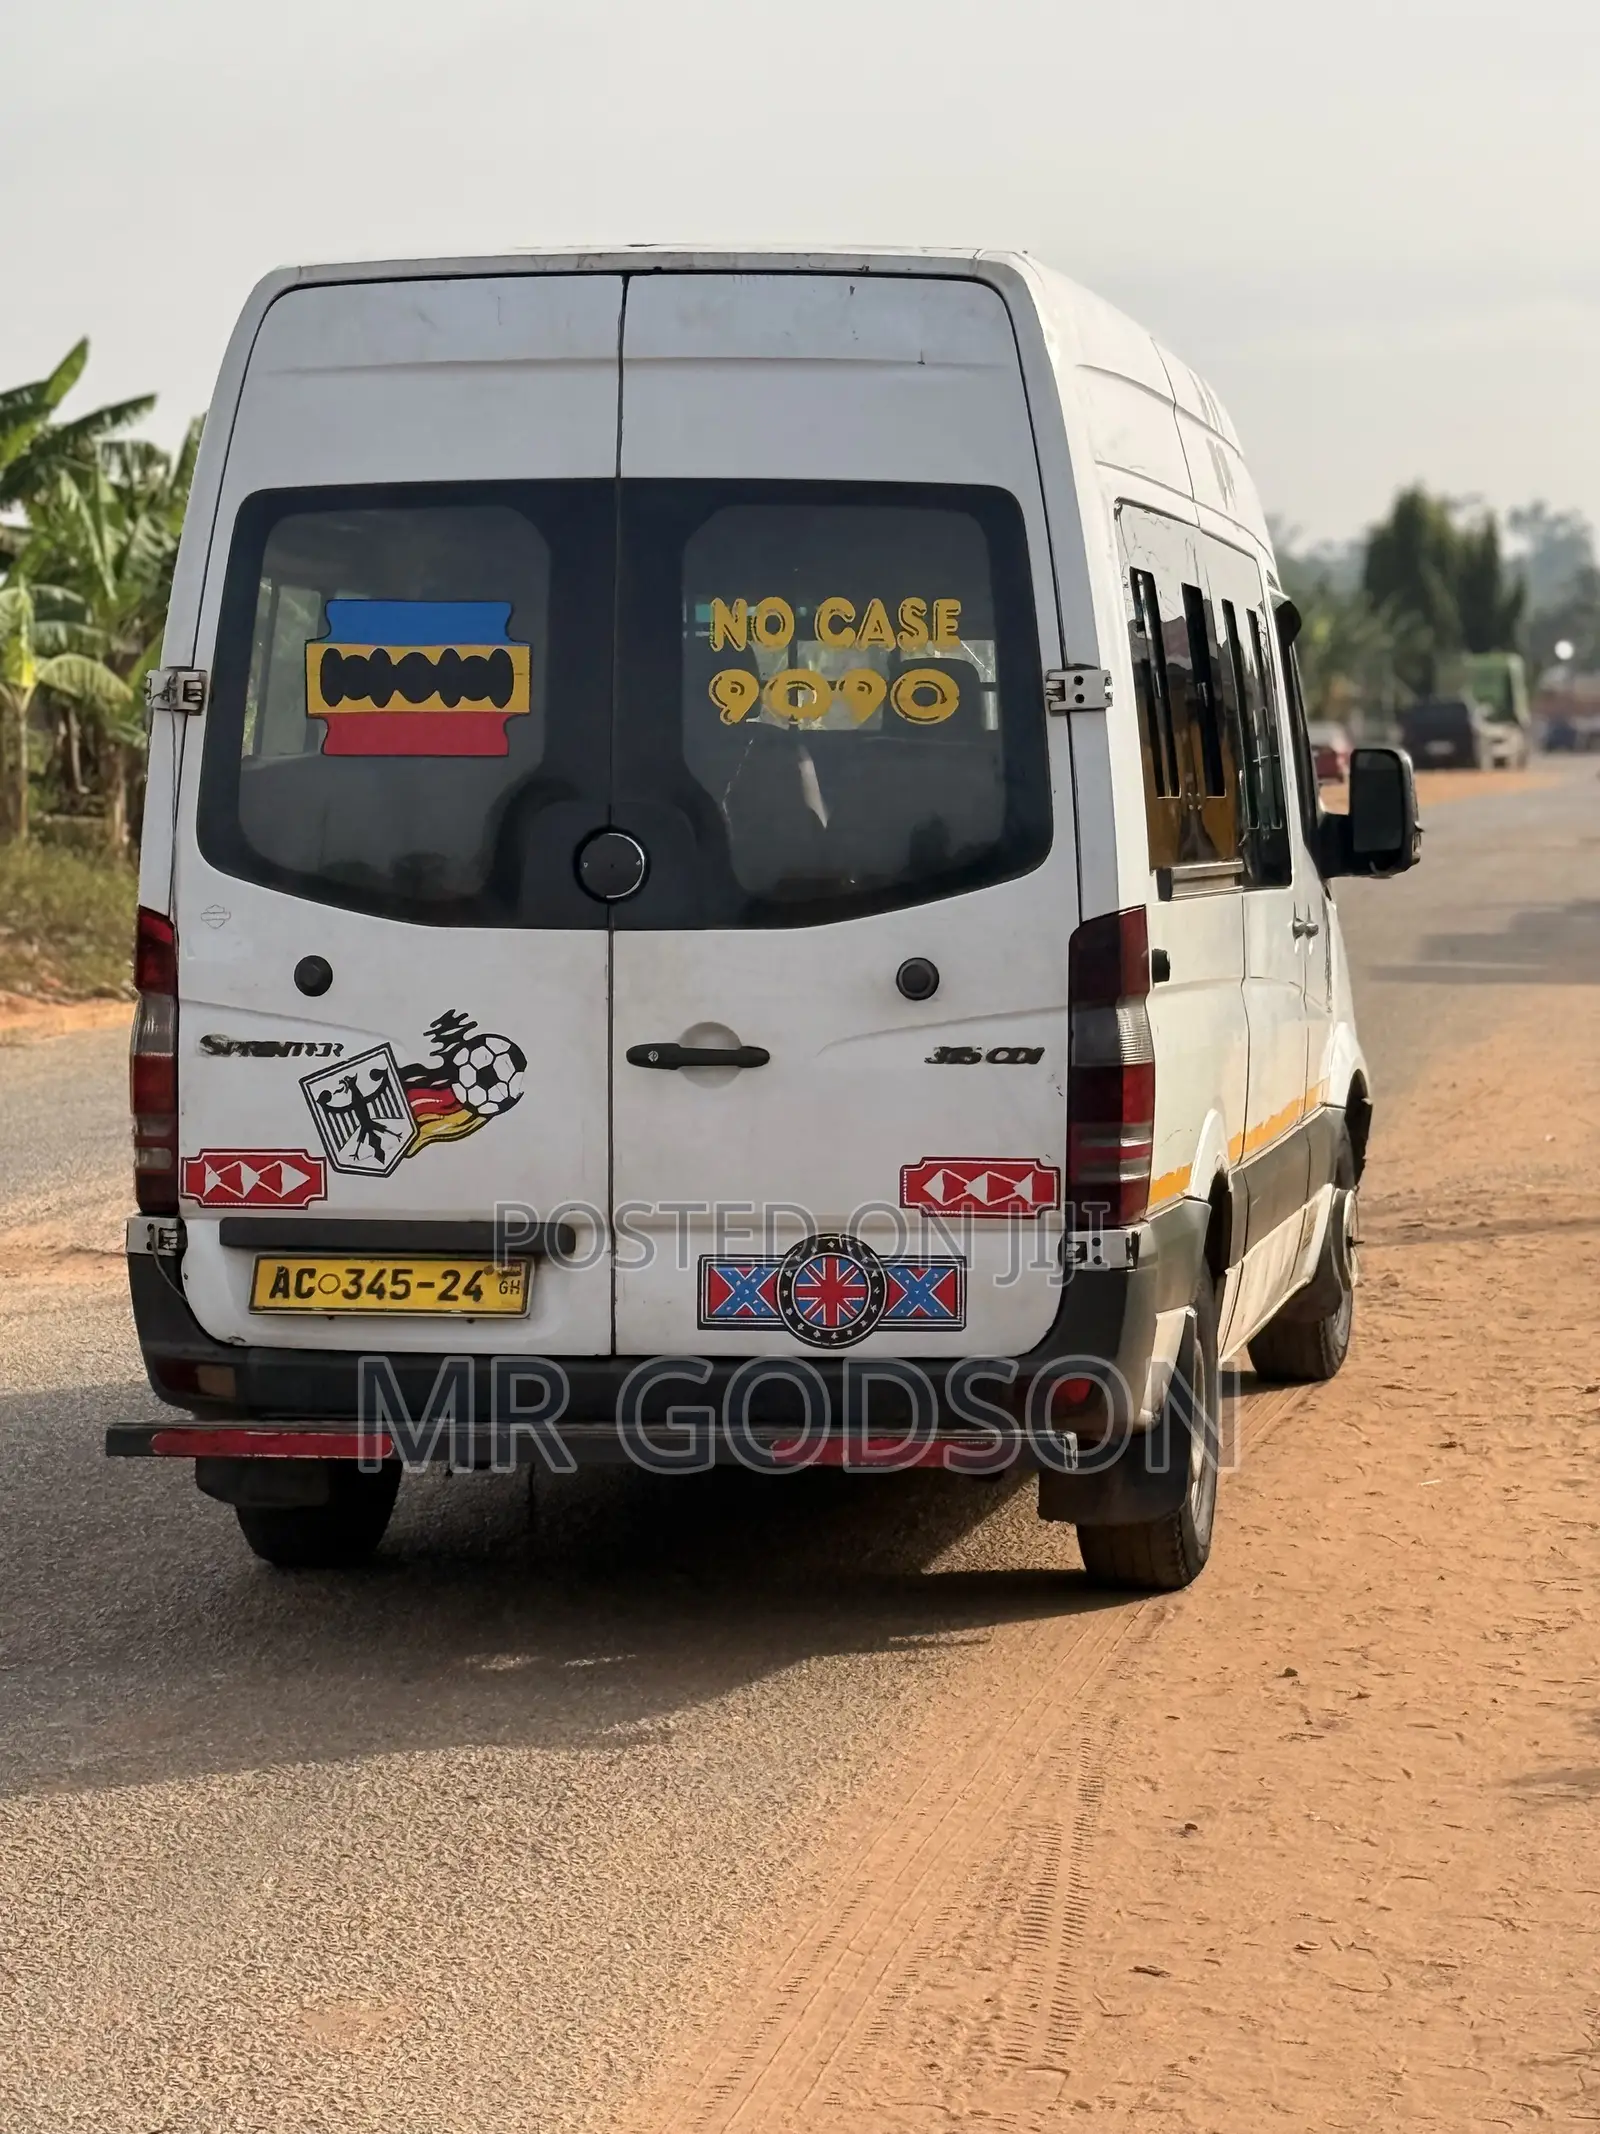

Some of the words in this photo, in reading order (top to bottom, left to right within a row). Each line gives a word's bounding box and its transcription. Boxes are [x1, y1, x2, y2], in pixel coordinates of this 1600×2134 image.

[710, 596, 795, 652] NO
[814, 596, 962, 652] CASE
[708, 668, 960, 725] 9090
[499, 1279, 521, 1295] GH
